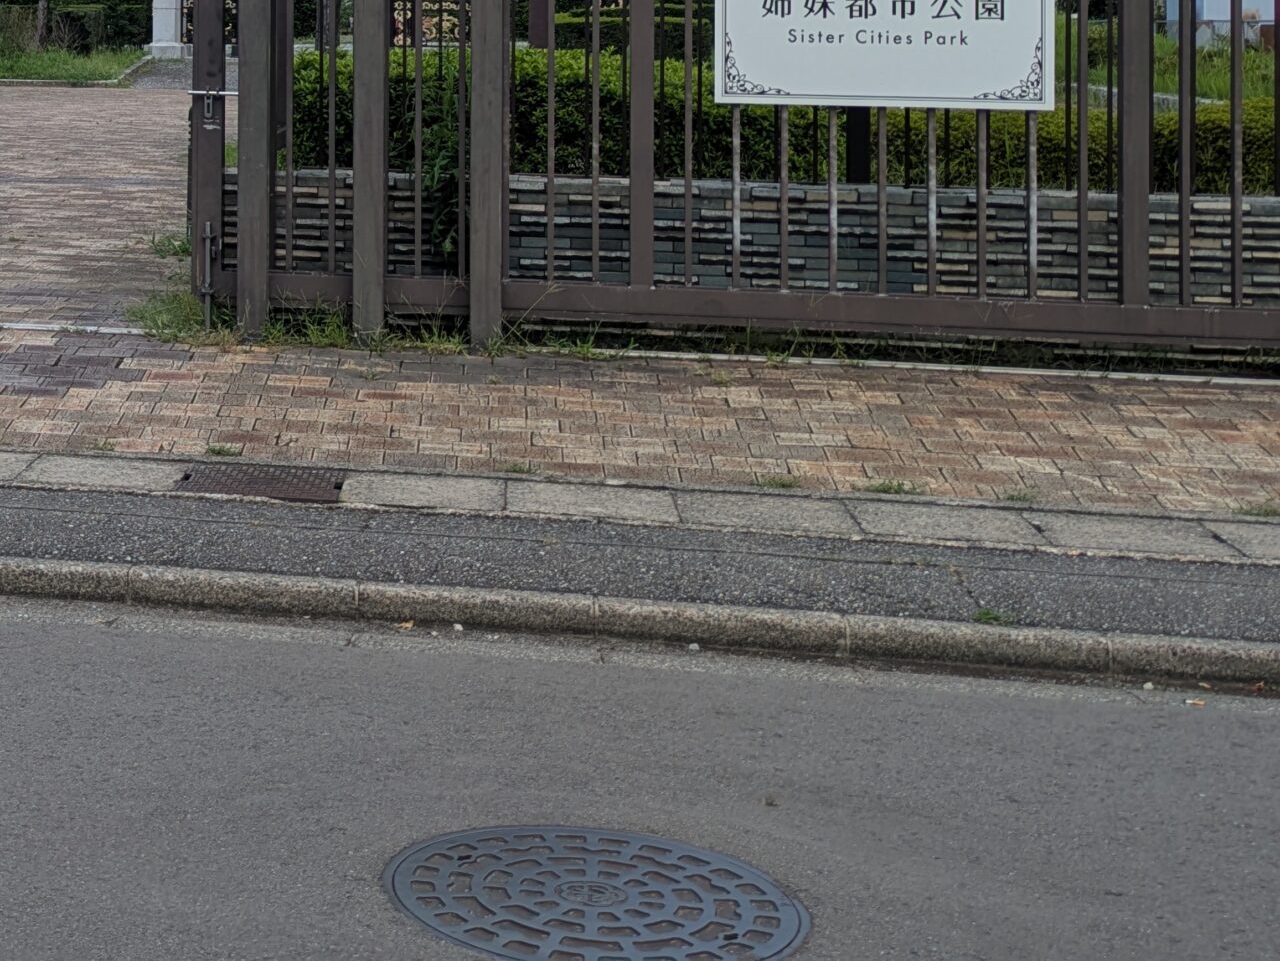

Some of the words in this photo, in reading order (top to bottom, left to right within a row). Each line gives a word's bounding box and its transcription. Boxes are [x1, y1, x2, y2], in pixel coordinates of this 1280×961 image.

[788, 28, 845, 44] Sister
[855, 29, 913, 45] Cities
[923, 30, 969, 46] Park
